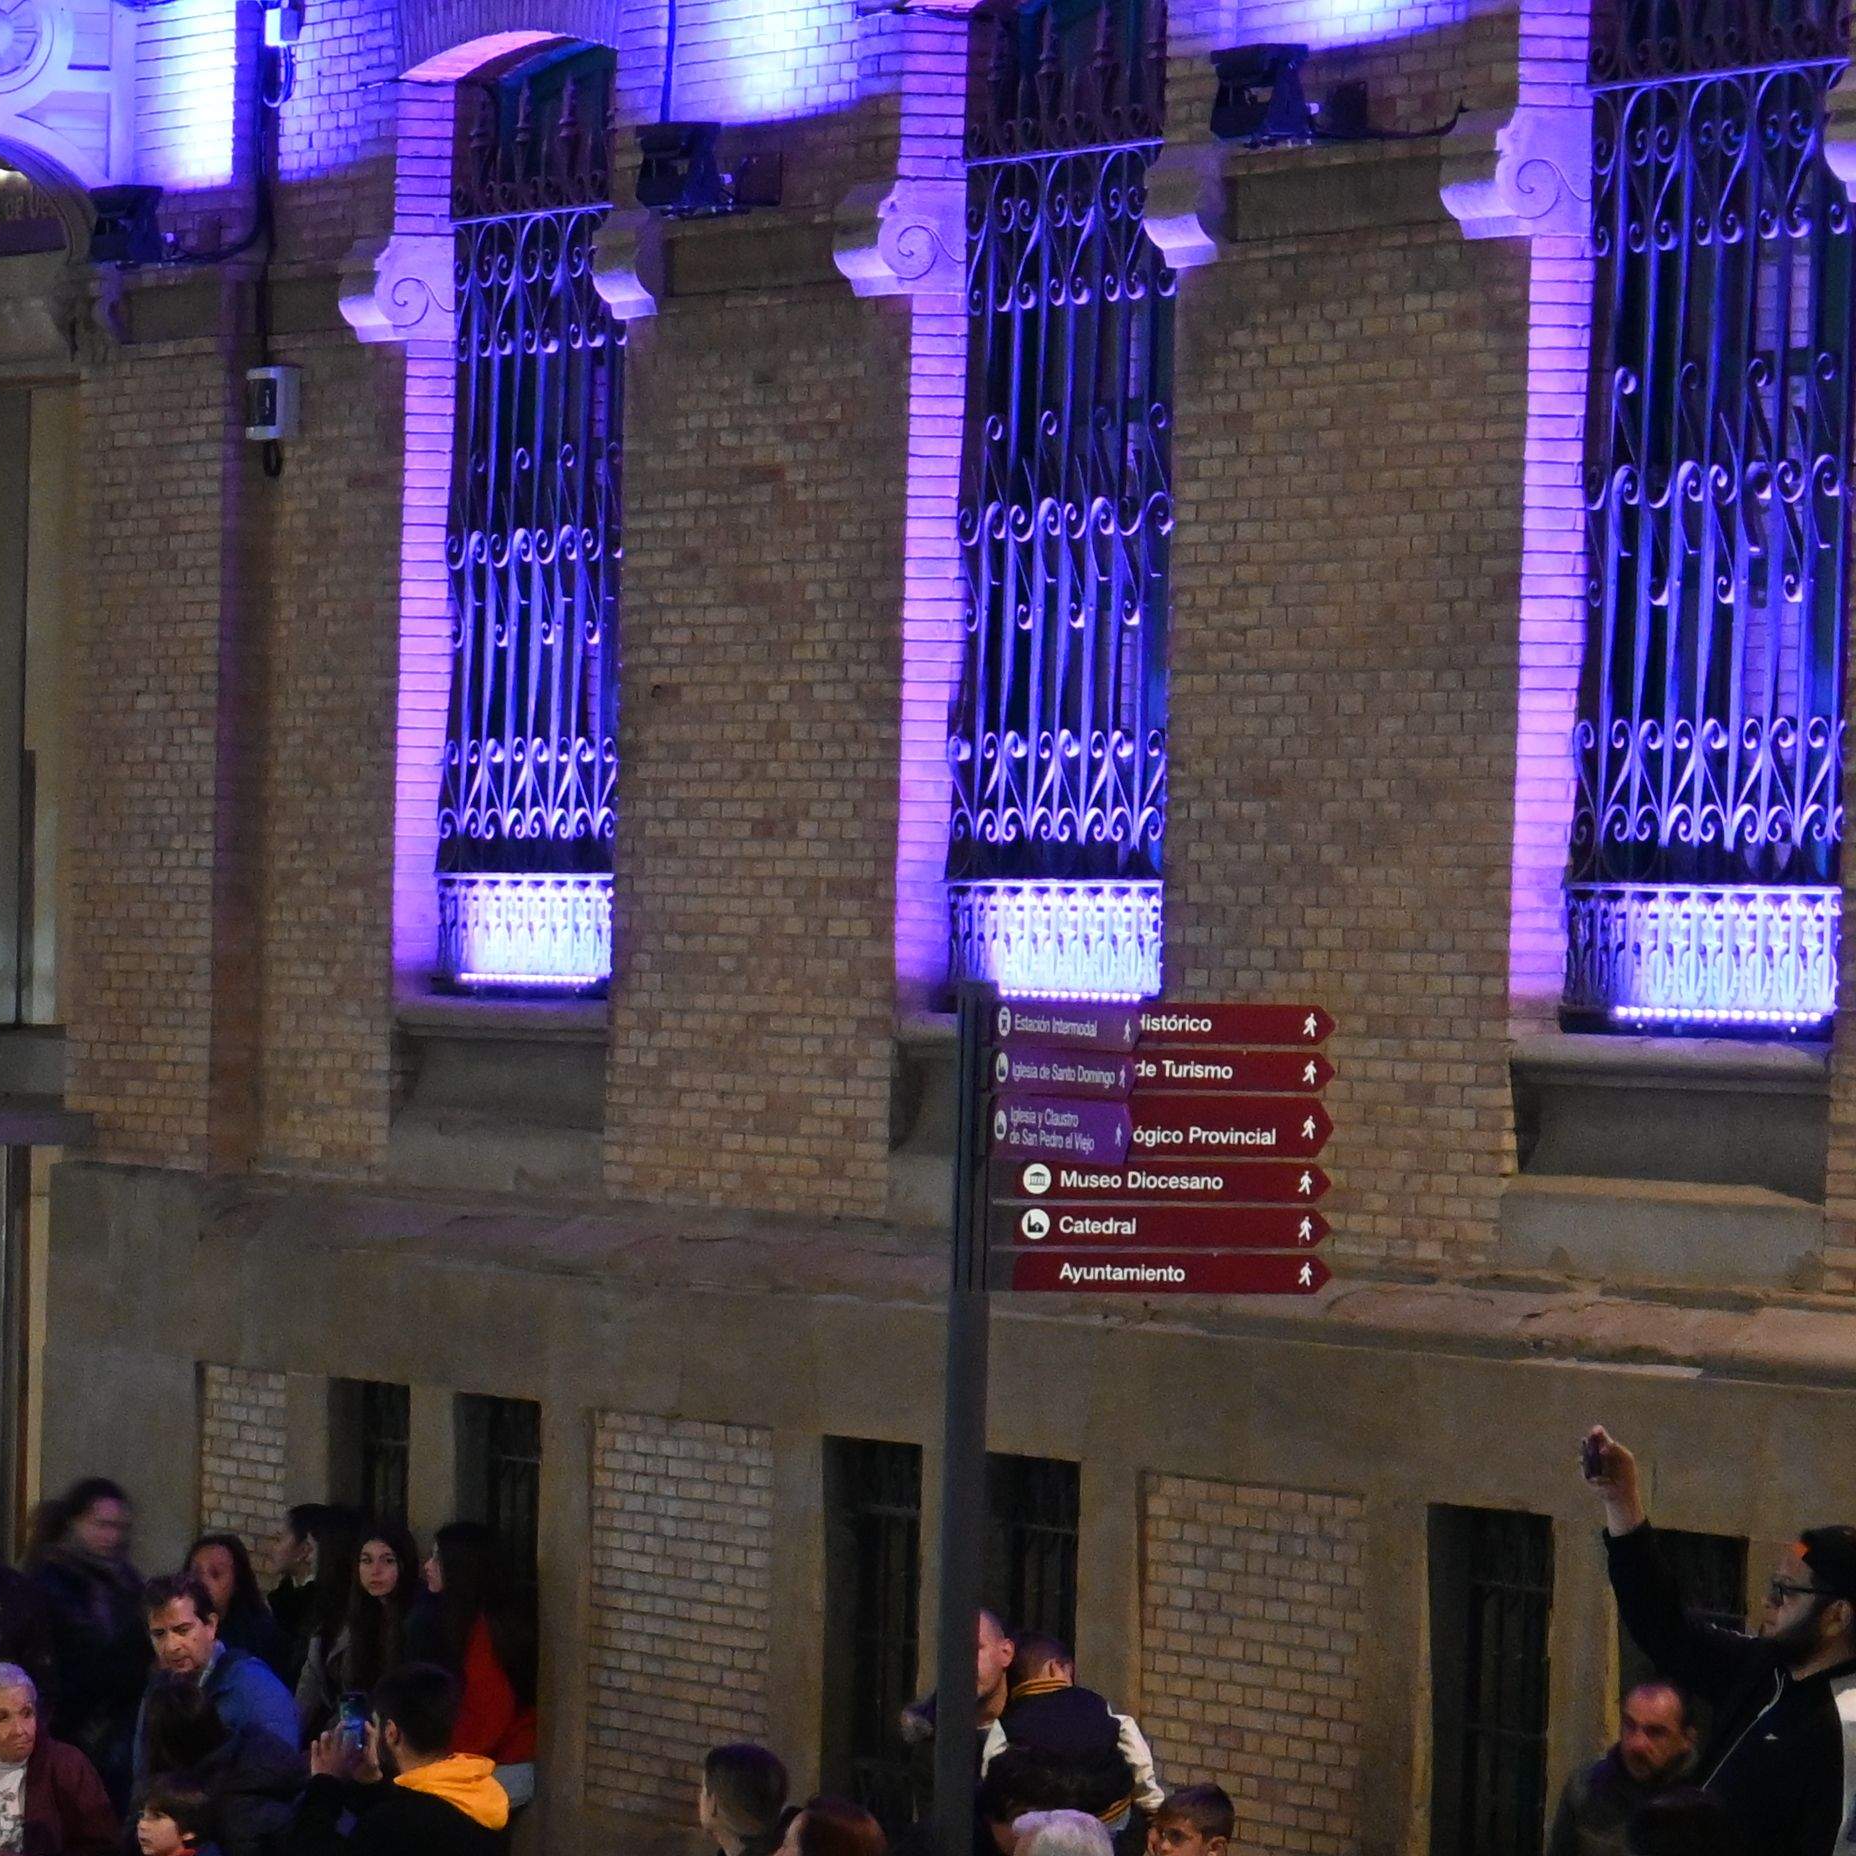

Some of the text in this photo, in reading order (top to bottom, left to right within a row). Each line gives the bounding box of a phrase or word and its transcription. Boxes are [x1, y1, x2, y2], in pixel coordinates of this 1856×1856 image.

[1014, 1013, 1098, 1038] Estación Intermodal
[1011, 1061, 1116, 1089] Iglesia de Santo Domingo
[1134, 1060, 1234, 1079] de Turismo
[1010, 1106, 1037, 1127] Iglesia
[1044, 1108, 1079, 1127] Claustro
[1009, 1128, 1021, 1145] de
[1021, 1128, 1038, 1146] San
[1039, 1130, 1064, 1149] Pedro
[1074, 1133, 1095, 1155] Viejo
[1188, 1126, 1277, 1145] Provincial
[1060, 1170, 1224, 1190] Museo Diocesano
[1059, 1216, 1137, 1235] Catedral
[1059, 1262, 1186, 1284] Ayuntamiento
